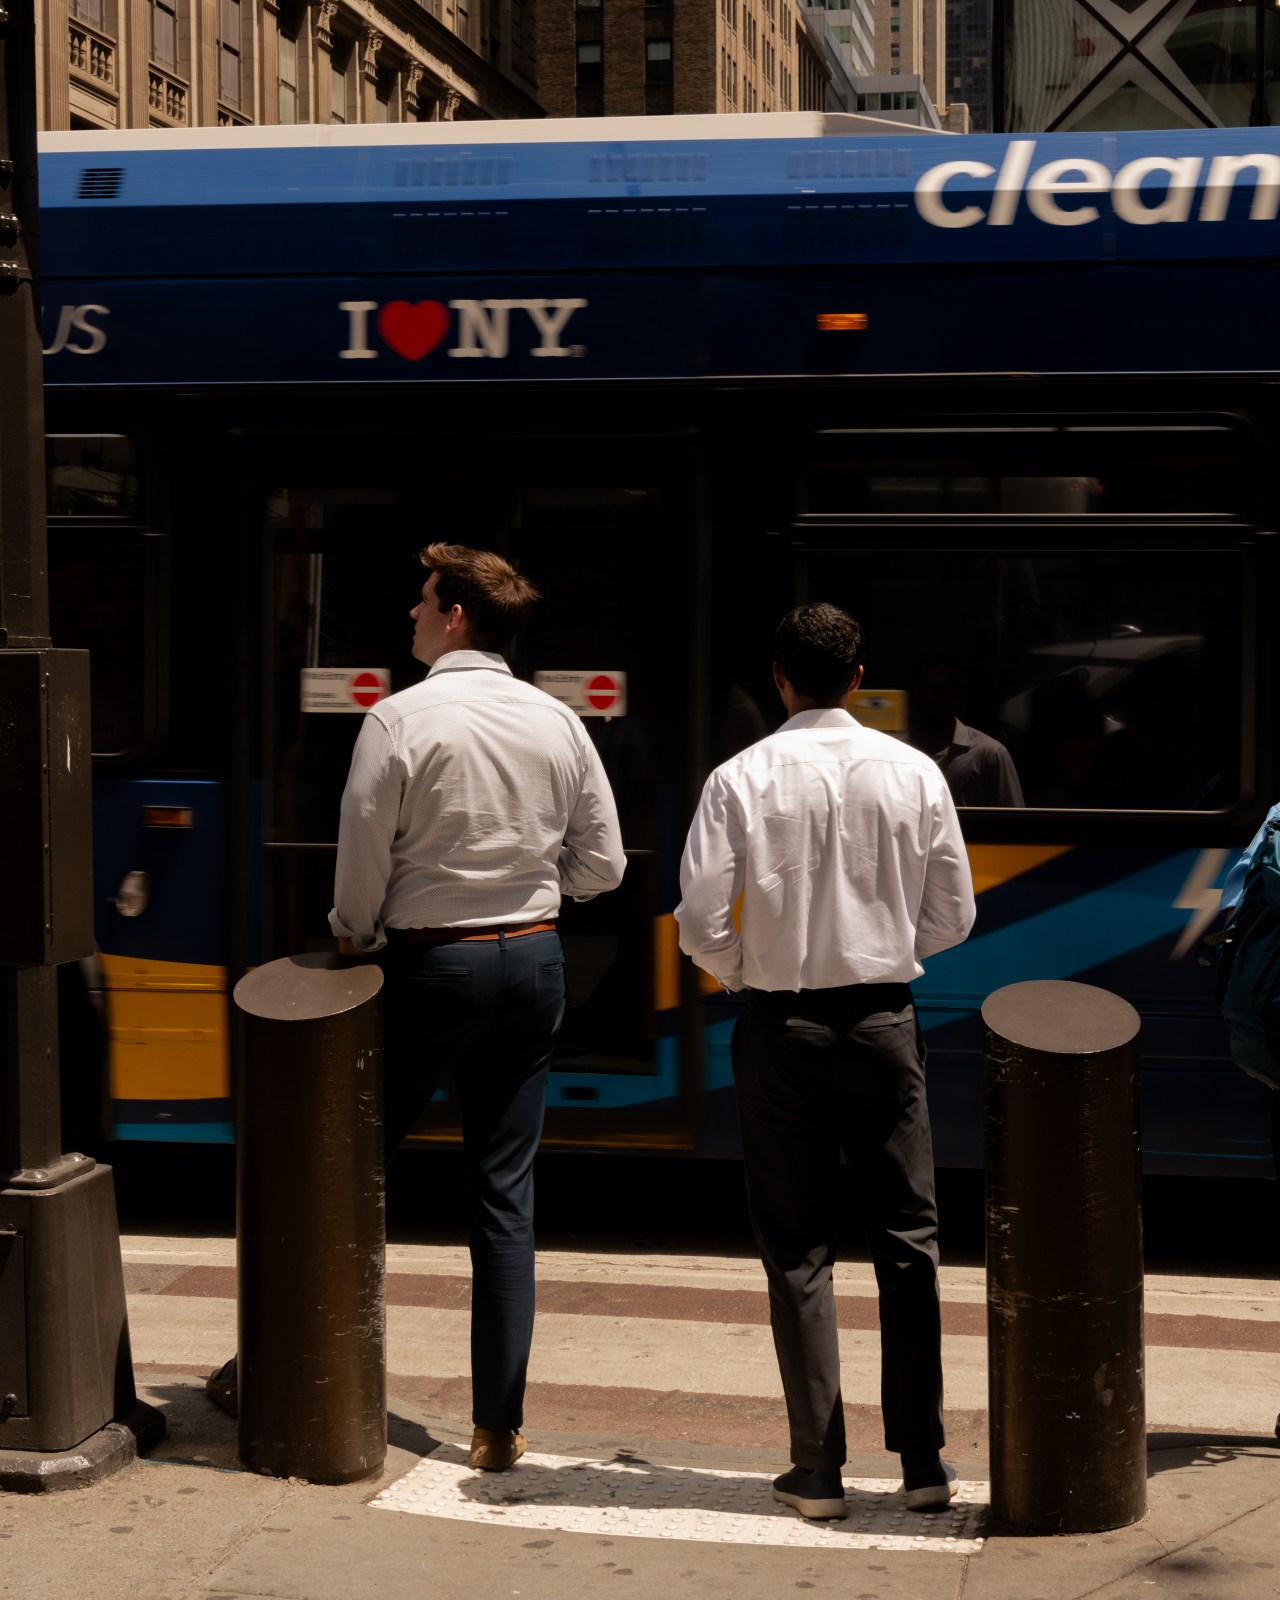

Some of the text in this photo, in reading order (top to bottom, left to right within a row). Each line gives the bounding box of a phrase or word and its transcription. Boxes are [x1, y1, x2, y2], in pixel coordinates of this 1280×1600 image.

[914, 140, 1280, 228] clean
[338, 298, 588, 359] I NY
